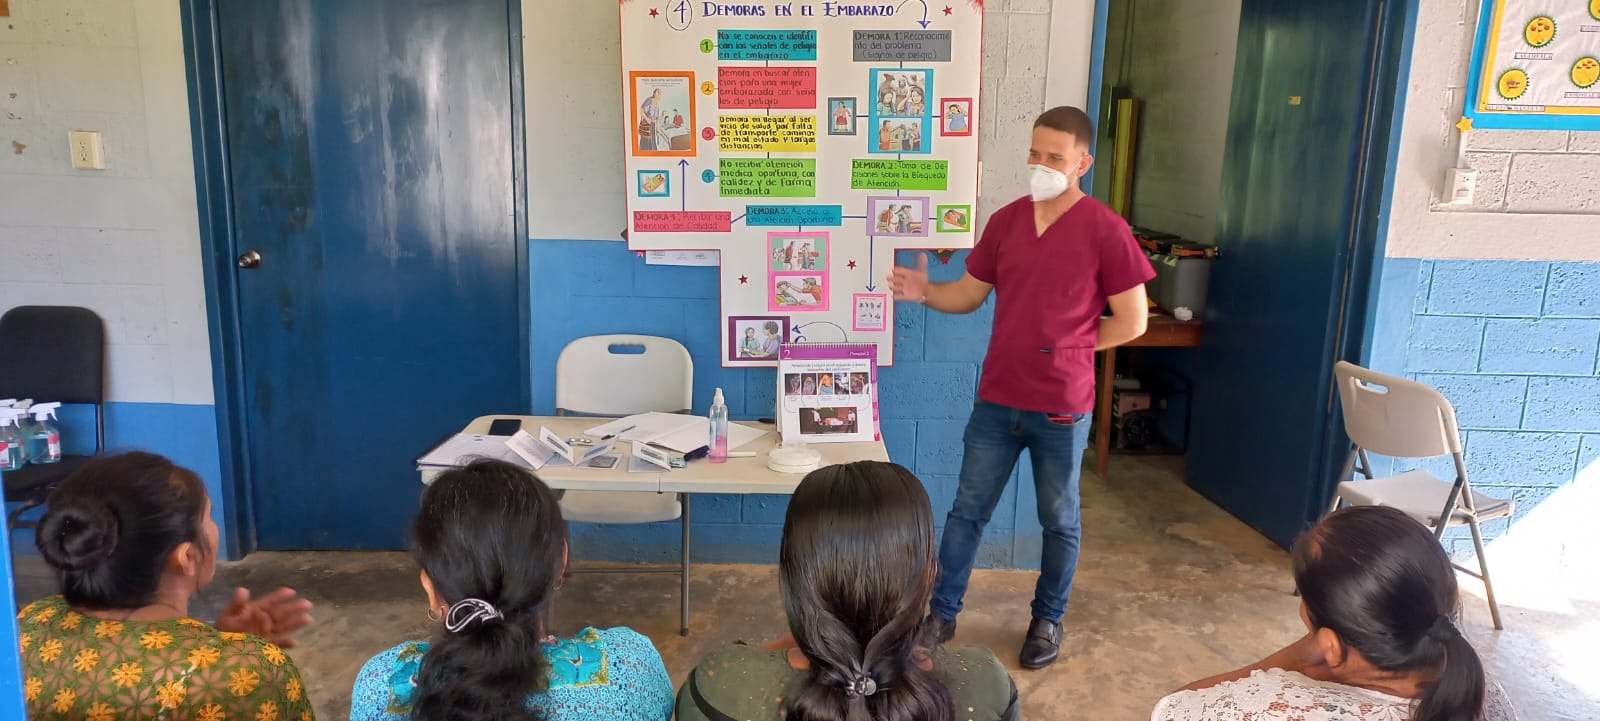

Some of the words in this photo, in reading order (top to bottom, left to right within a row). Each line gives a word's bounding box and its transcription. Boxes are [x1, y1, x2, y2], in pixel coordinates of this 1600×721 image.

[673, 0, 687, 24] 4
[702, 1, 766, 17] DEMORAS
[775, 2, 792, 16] EN
[801, 5, 814, 16] EL
[821, 1, 894, 17] EMBARAZO
[718, 32, 729, 40] No
[855, 32, 891, 41] DEMORA
[720, 160, 732, 168] No
[853, 161, 886, 169] DEMORA
[748, 207, 779, 215] DEMORA
[783, 349, 792, 360] 2
